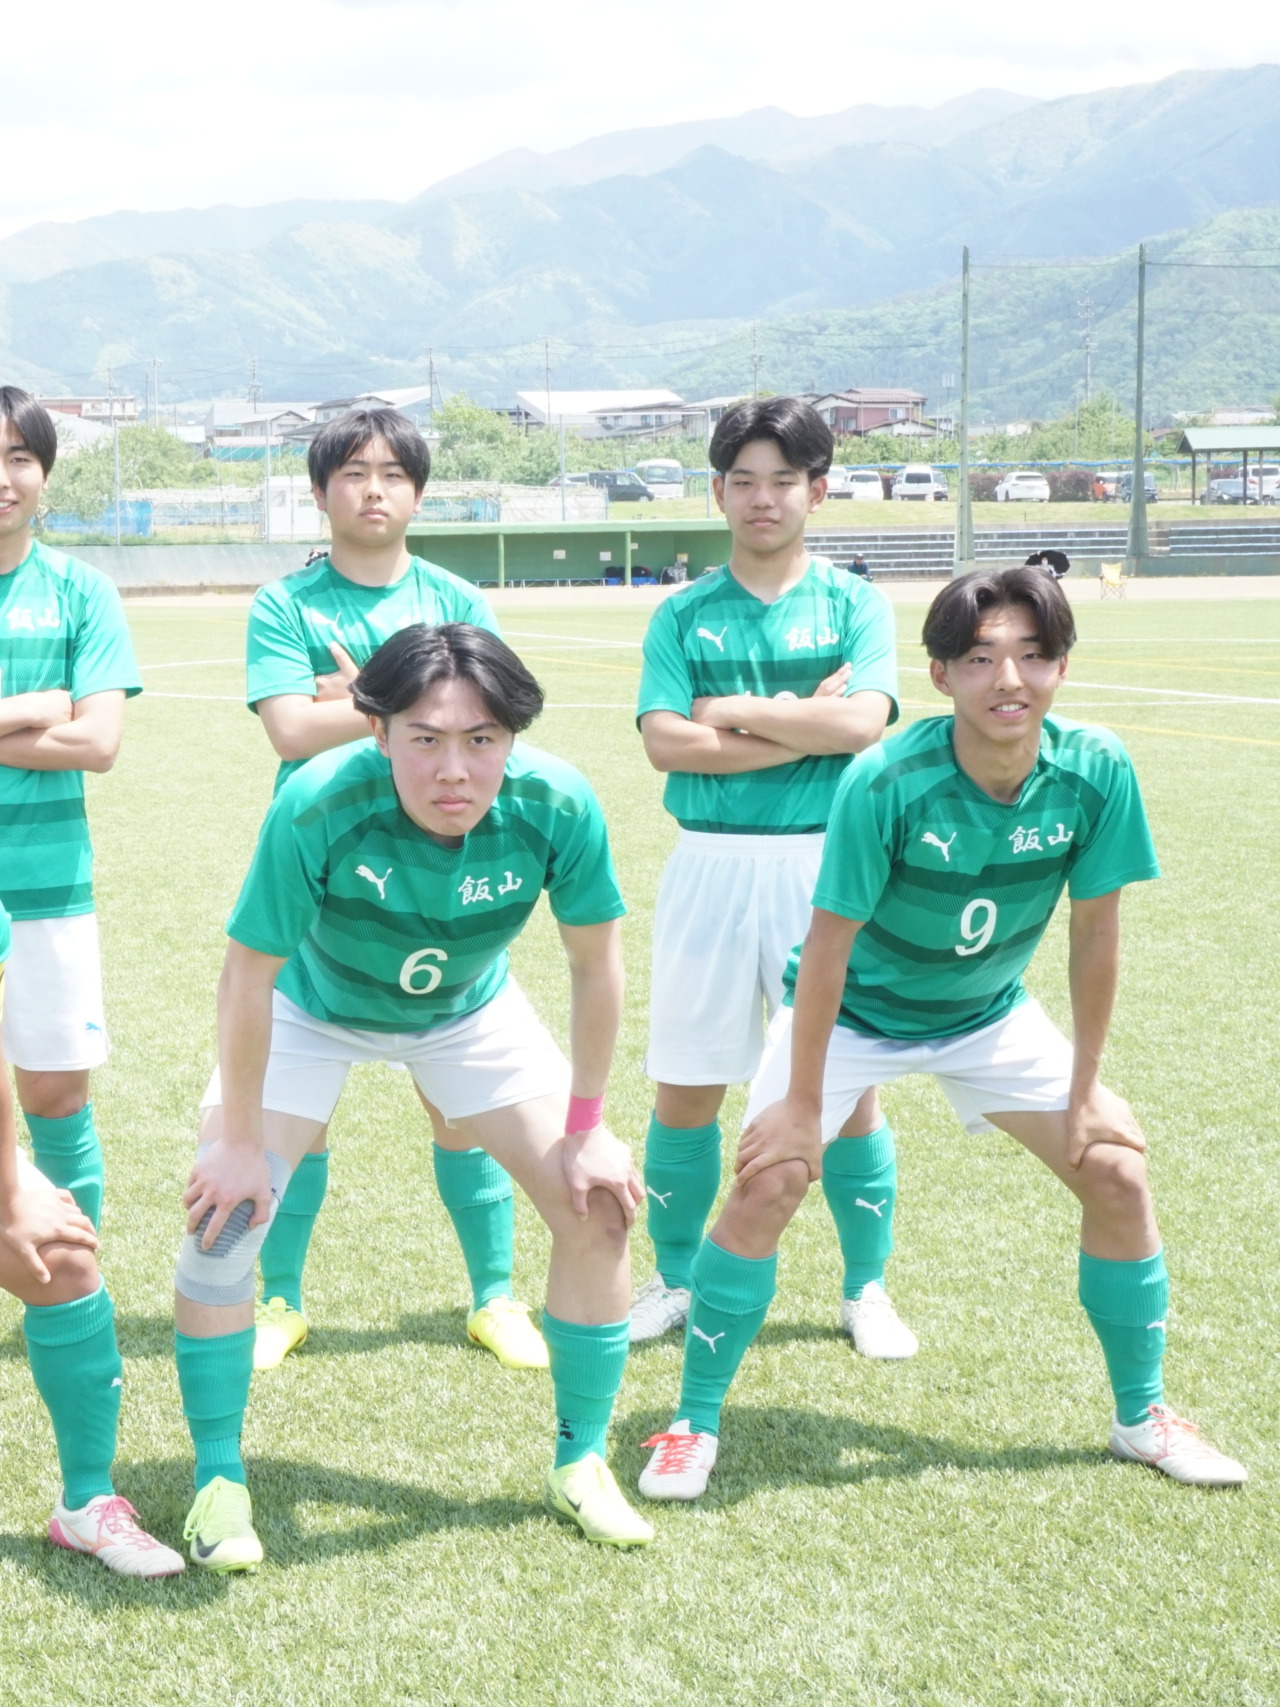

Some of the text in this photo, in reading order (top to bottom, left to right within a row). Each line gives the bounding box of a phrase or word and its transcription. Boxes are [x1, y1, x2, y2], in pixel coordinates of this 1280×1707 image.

[785, 627, 839, 651] 飯山
[1008, 823, 1074, 854] 飯山
[458, 871, 522, 905] 飯山
[955, 898, 997, 956] 9
[399, 947, 448, 995] 6
